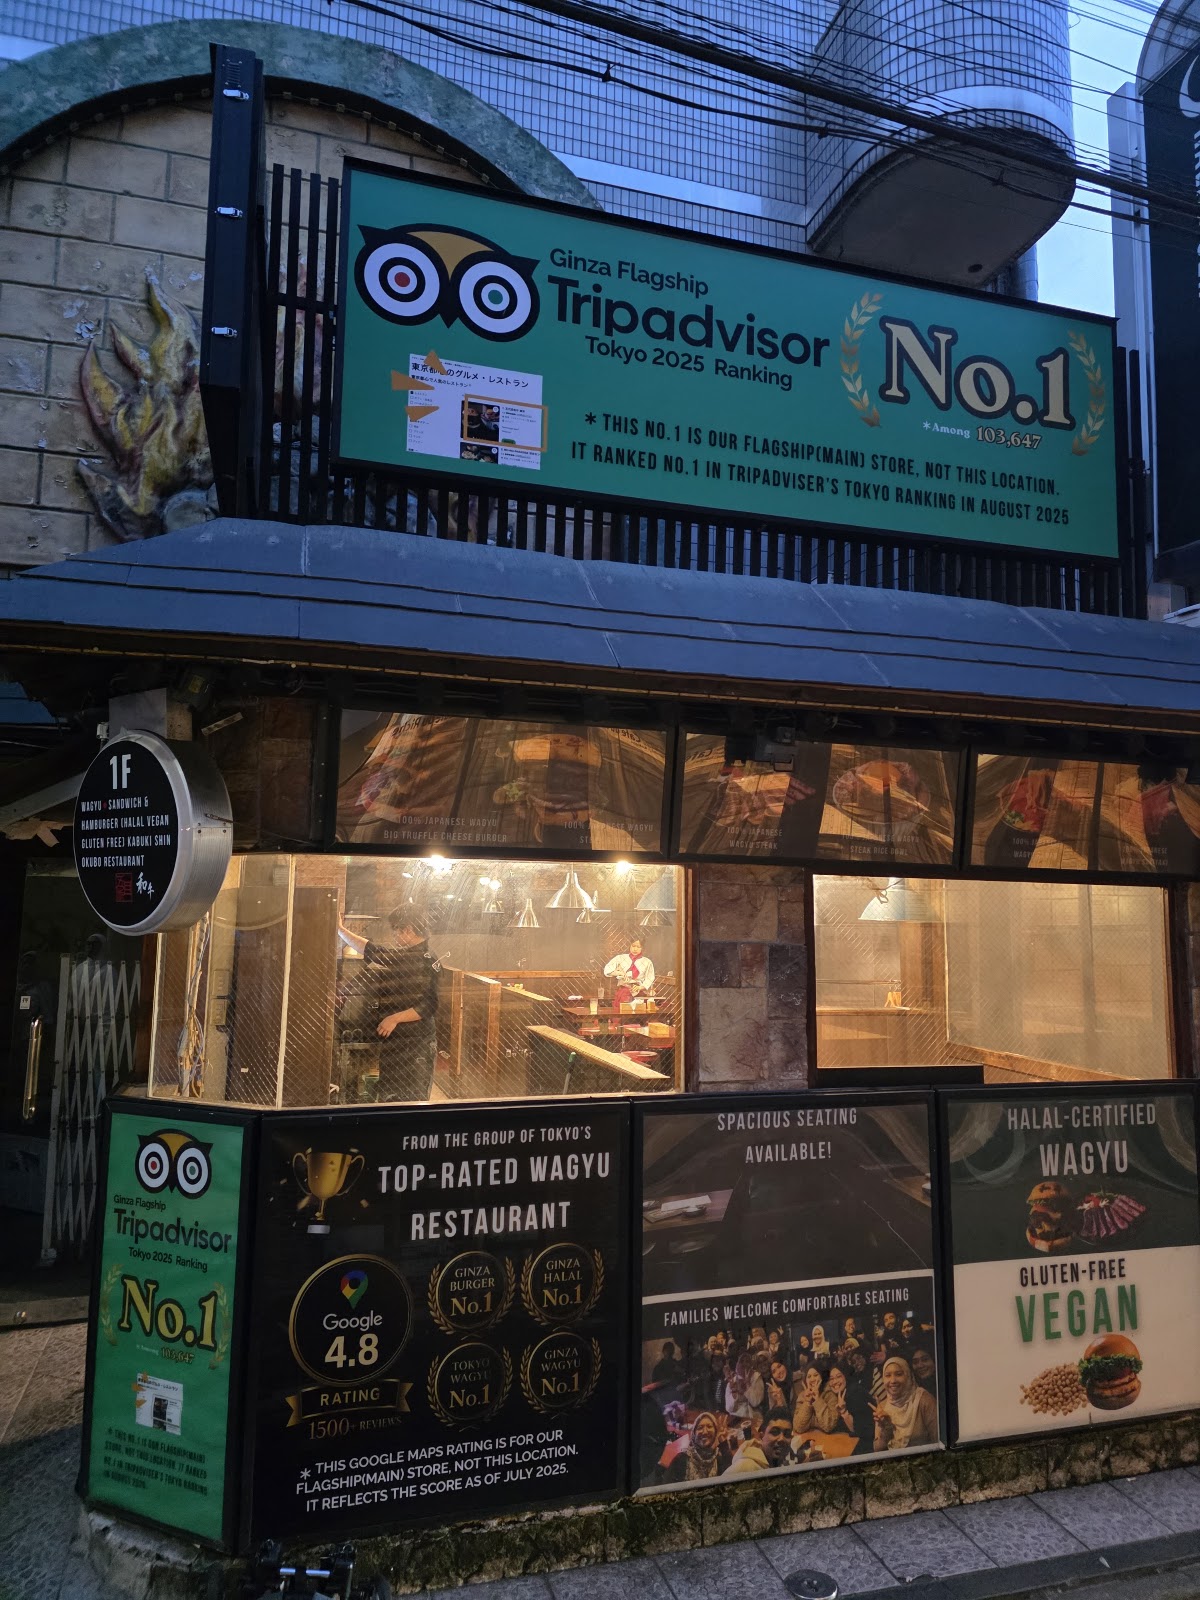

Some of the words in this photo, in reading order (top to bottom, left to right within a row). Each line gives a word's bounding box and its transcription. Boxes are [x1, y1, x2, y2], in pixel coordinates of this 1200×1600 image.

[550, 248, 611, 278] Ginza
[617, 261, 709, 298] Flagship
[548, 275, 830, 367] Tripadvisor
[412, 362, 529, 388] 東京都のグルメ・レストラン
[585, 336, 647, 364] Tokyo
[652, 350, 704, 372] 2025
[715, 358, 792, 391] Ranking
[879, 315, 1076, 431] No.1
[976, 427, 1041, 449] 103,647
[603, 413, 639, 437] THIS
[645, 420, 681, 443] NO.1
[688, 424, 702, 445] IS
[708, 427, 738, 450] OUR
[744, 435, 866, 469] FLAGSHIP(MAIN)
[871, 455, 919, 478] STORE,
[925, 461, 951, 481] NOT
[956, 465, 987, 486] THIS
[992, 471, 1060, 496] LOCATION.
[571, 441, 586, 460] IT
[593, 445, 657, 469] RANKED
[664, 452, 699, 475] NO.1
[706, 458, 722, 478] IN
[727, 464, 839, 494] TRIPADVISER'S
[845, 480, 890, 502] TOKYO
[895, 487, 956, 510] RANKING
[961, 493, 975, 512] IN
[980, 498, 1031, 521] AUGUST
[1036, 505, 1069, 525] 2025
[109, 754, 132, 790] 1F
[81, 801, 102, 812] WAGYU
[108, 797, 142, 811] SANDWICH
[144, 797, 149, 808] &
[81, 818, 119, 831] HAMBURGER
[147, 815, 169, 827] VEGAN
[424, 816, 465, 827] JAPANESE
[469, 818, 497, 827] WAGYU
[628, 823, 654, 832] WAGYU
[748, 828, 782, 837] JAPANESE
[81, 837, 105, 849] GLUTEN
[127, 835, 152, 847] KABUKI
[154, 834, 171, 846] SHIN
[383, 830, 398, 840] BIG
[402, 831, 438, 841] TRUFFLE
[441, 832, 472, 842] CHEESE
[475, 833, 507, 843] BURGER
[729, 840, 754, 849] WAGYU
[755, 841, 778, 850] STEAK
[81, 856, 102, 868] OKUBO
[104, 854, 145, 867] RESTAURANT
[850, 845, 871, 854] STEAK
[874, 847, 888, 855] RICE
[717, 1110, 790, 1131] SPACIOUS
[797, 1107, 857, 1127] SEATING
[1007, 1103, 1156, 1130] HALAL-CERTIFIED
[402, 1134, 438, 1151] FROM
[444, 1131, 468, 1149] THE
[474, 1129, 515, 1147] GROUP
[520, 1128, 535, 1144] OF
[540, 1125, 592, 1143] TOKYO'S
[745, 1141, 832, 1164] AVAILABLE!
[1040, 1140, 1128, 1177] WAGYU
[378, 1158, 518, 1194] TOP-RATED
[530, 1152, 611, 1183] WAGYU
[114, 1194, 134, 1206] Ginza
[135, 1197, 167, 1212] Flagship
[114, 1208, 232, 1254] Tripadvisor
[410, 1201, 571, 1241] RESTAURANT
[128, 1247, 152, 1260] Tokyo
[152, 1251, 173, 1264] 2025
[176, 1256, 208, 1273] Ranking
[454, 1265, 491, 1279] GINZA
[546, 1258, 581, 1272] GINZA
[450, 1277, 496, 1292] BURGER
[544, 1270, 583, 1285] HALAL
[1019, 1257, 1126, 1288] GLUTEN-FREE
[449, 1291, 493, 1317] No.1
[542, 1284, 583, 1308] No.1
[664, 1307, 719, 1327] FAMILIES
[723, 1301, 779, 1320] WELCOME
[782, 1293, 861, 1314] COMFORTABLE
[865, 1288, 909, 1305] SEATING
[118, 1274, 218, 1351] No.1
[323, 1310, 383, 1332] Google
[1014, 1284, 1138, 1343] VEGAN
[161, 1347, 195, 1364] 103,647
[324, 1332, 380, 1369] 4.8
[544, 1347, 579, 1360] GINZA
[451, 1358, 490, 1371] TOKYO
[540, 1358, 582, 1373] WAGYU
[450, 1370, 491, 1384] WAGYU
[540, 1372, 580, 1397] No.1
[320, 1387, 381, 1407] RATING
[449, 1383, 490, 1409] No.1
[359, 1414, 403, 1431] REVIEWS
[315, 1460, 346, 1475] THIS
[349, 1451, 405, 1470] GOOGLE
[407, 1445, 443, 1462] MAPS
[446, 1439, 493, 1456] RATING
[495, 1437, 507, 1449] IS
[509, 1433, 534, 1448] FOR
[536, 1429, 563, 1444] OUR
[296, 1466, 404, 1495] FLAGSHIP(MAIN)
[407, 1462, 451, 1480] STORE,
[454, 1457, 481, 1473] NOT
[484, 1453, 513, 1468] THIS
[515, 1444, 579, 1465] LOCATION.
[306, 1499, 320, 1512] IT
[321, 1490, 388, 1510] REFLECTS
[391, 1485, 417, 1500] THE
[419, 1479, 463, 1497] SCORE
[465, 1476, 482, 1489] AS
[484, 1473, 501, 1486] OF
[504, 1467, 533, 1483] JULY
[536, 1463, 569, 1478] 2025.
